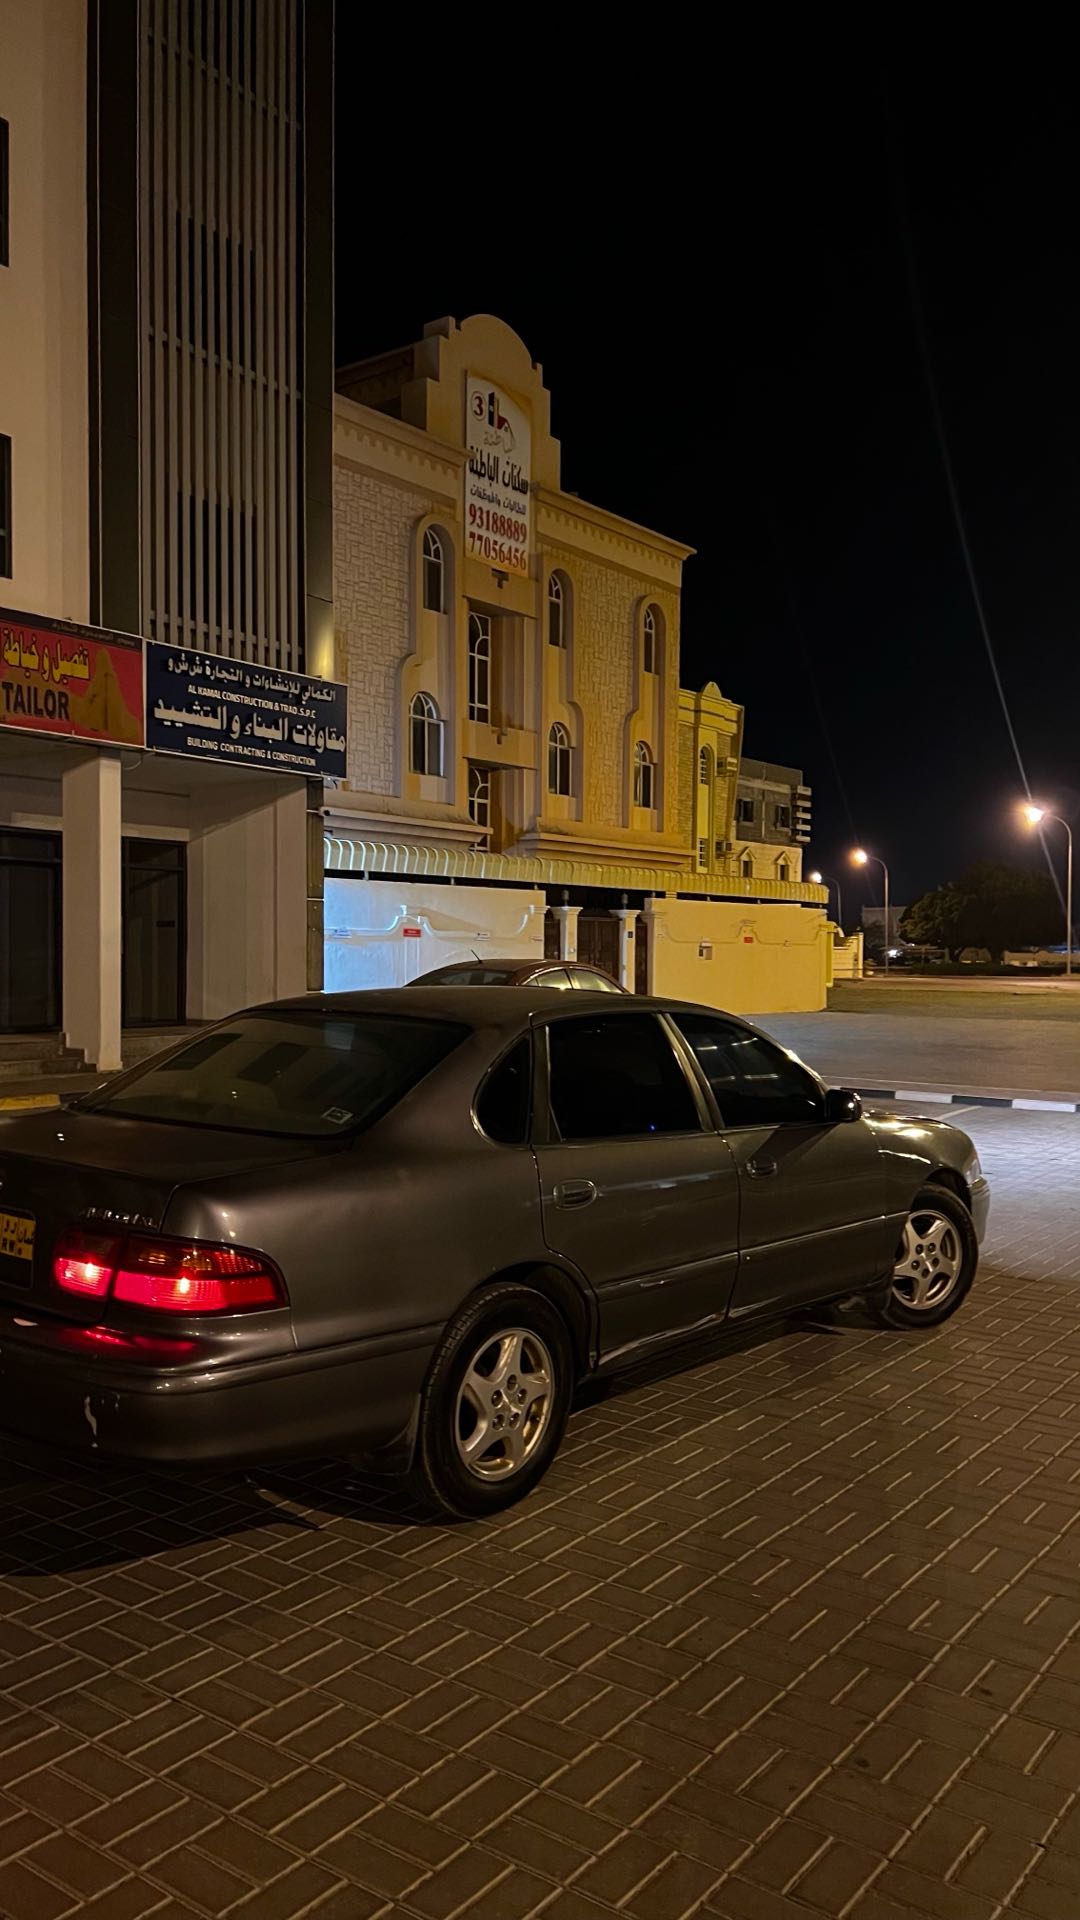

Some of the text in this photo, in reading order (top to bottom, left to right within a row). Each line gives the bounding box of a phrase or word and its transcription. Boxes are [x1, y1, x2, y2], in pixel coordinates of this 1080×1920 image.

[474, 396, 484, 416] 3
[469, 503, 527, 543] 93188889
[469, 531, 527, 570] 77056456
[205, 660, 243, 683] التجارة
[245, 675, 251, 689] و
[1, 681, 71, 720] TAILOR
[187, 684, 197, 694] AL
[197, 686, 222, 699] KAMAL
[221, 690, 274, 710] CONSTRUCTION
[274, 702, 280, 711] &
[301, 685, 336, 704] الكمالي
[153, 698, 346, 754] مقاولات البناء و التشييد
[186, 736, 218, 751] BUILDING
[220, 742, 267, 760] CONTRACTING
[272, 752, 316, 767] CONSTRUCTION
